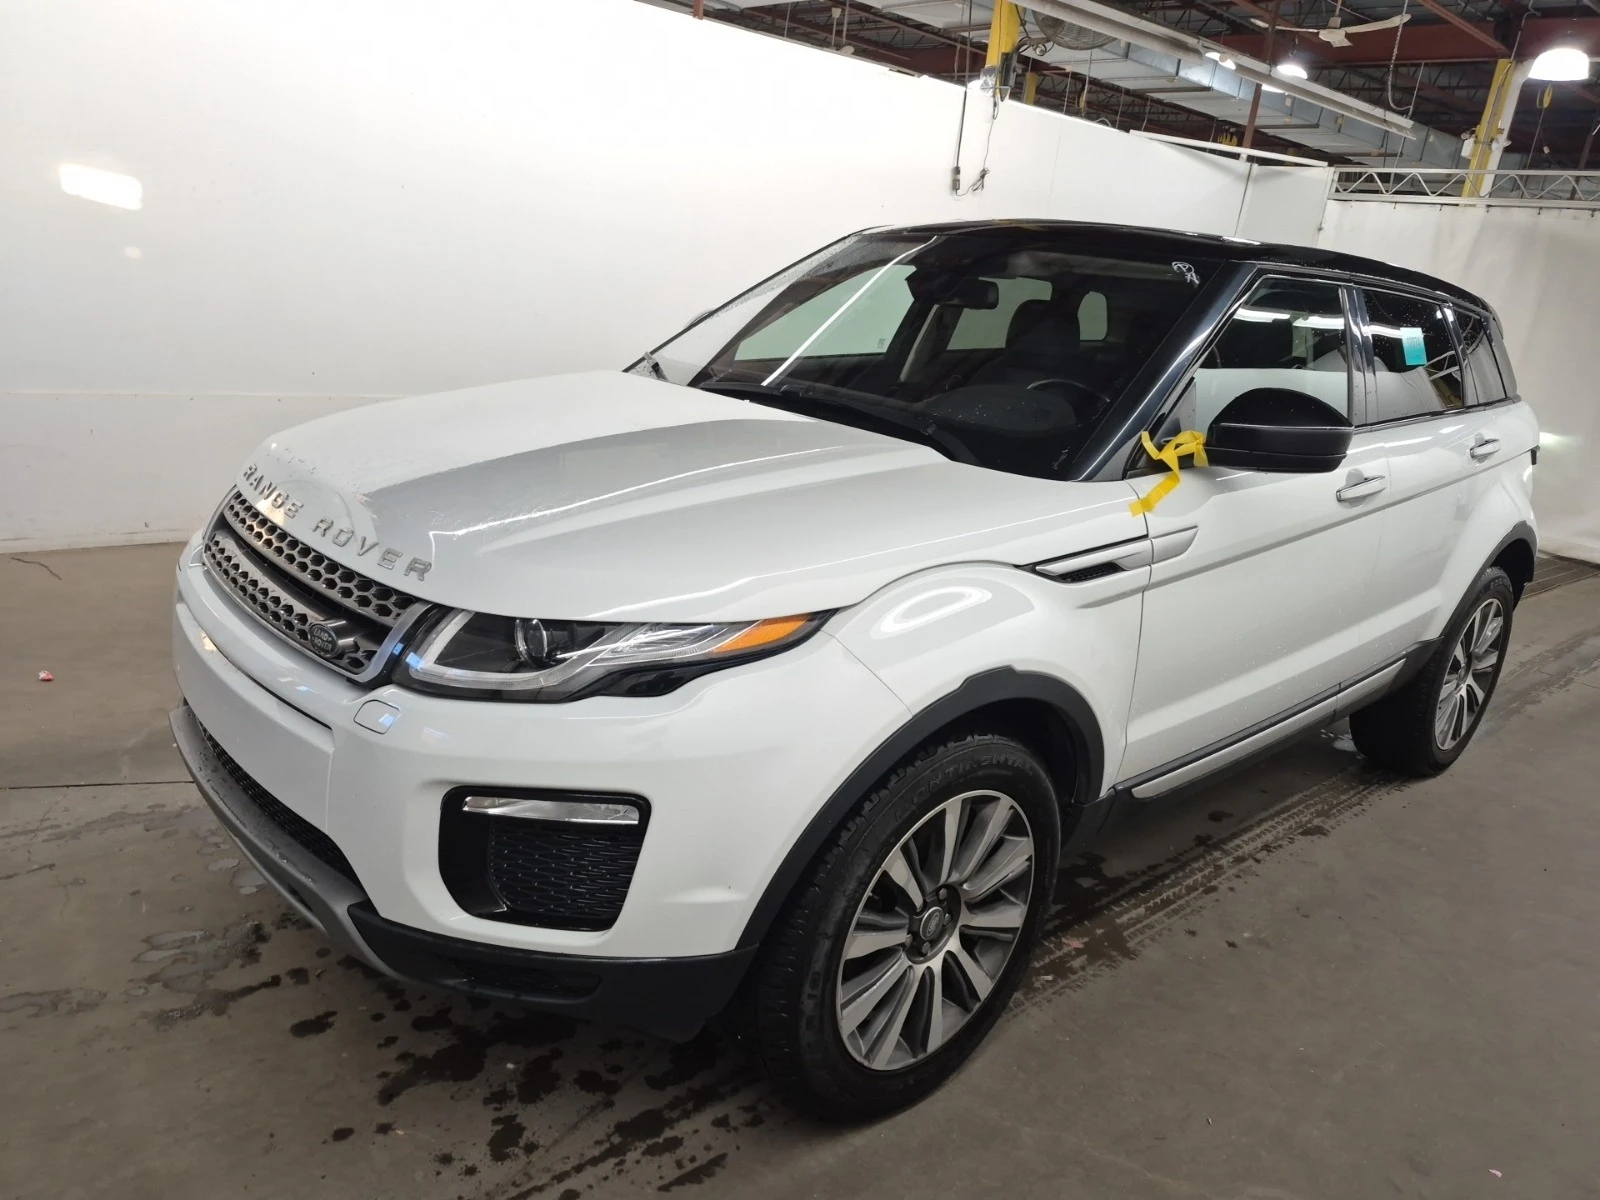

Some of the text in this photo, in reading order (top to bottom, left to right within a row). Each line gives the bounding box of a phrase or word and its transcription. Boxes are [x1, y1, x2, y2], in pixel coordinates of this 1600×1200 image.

[242, 463, 433, 581] RANGE ROVER
[313, 627, 329, 641] LAND
[313, 636, 332, 652] ROVER
